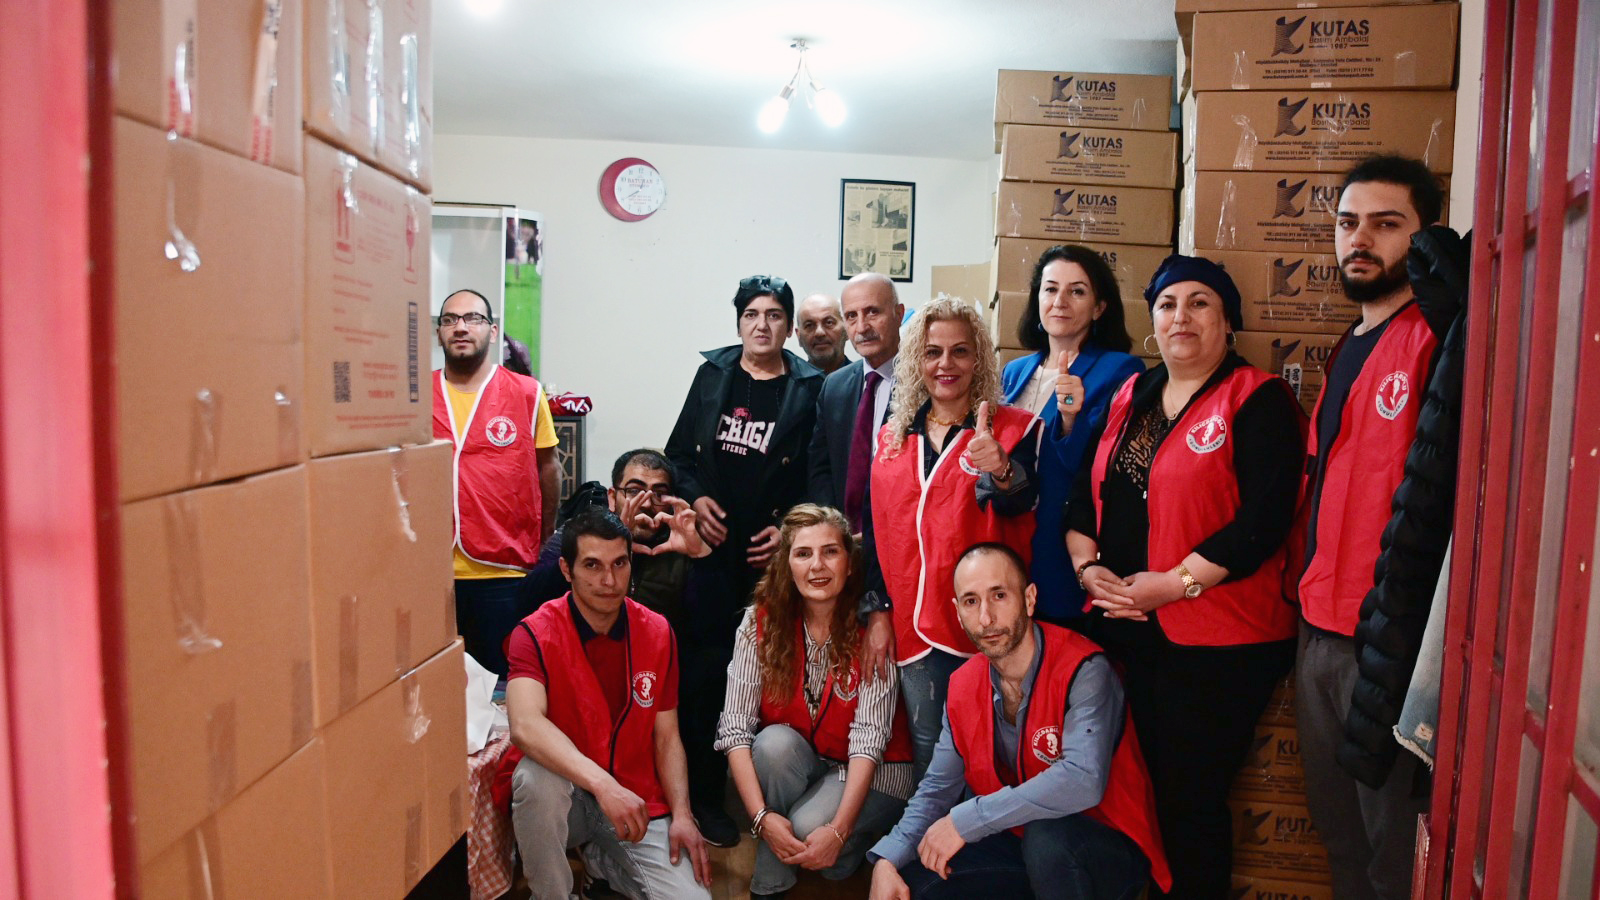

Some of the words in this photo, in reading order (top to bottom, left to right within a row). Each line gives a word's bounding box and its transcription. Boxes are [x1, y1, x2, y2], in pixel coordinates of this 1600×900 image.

[1311, 20, 1369, 36] KUTAS
[1077, 80, 1116, 92] KUTAS
[1313, 103, 1370, 118] KUTAS
[1083, 136, 1123, 149] KUTAS
[1077, 194, 1117, 206] KUTAS
[1311, 186, 1342, 201] KUT
[1307, 265, 1341, 281] KUT
[721, 442, 748, 456] AVENUE
[1275, 816, 1316, 833] KUTA
[1256, 891, 1312, 900] KUT
